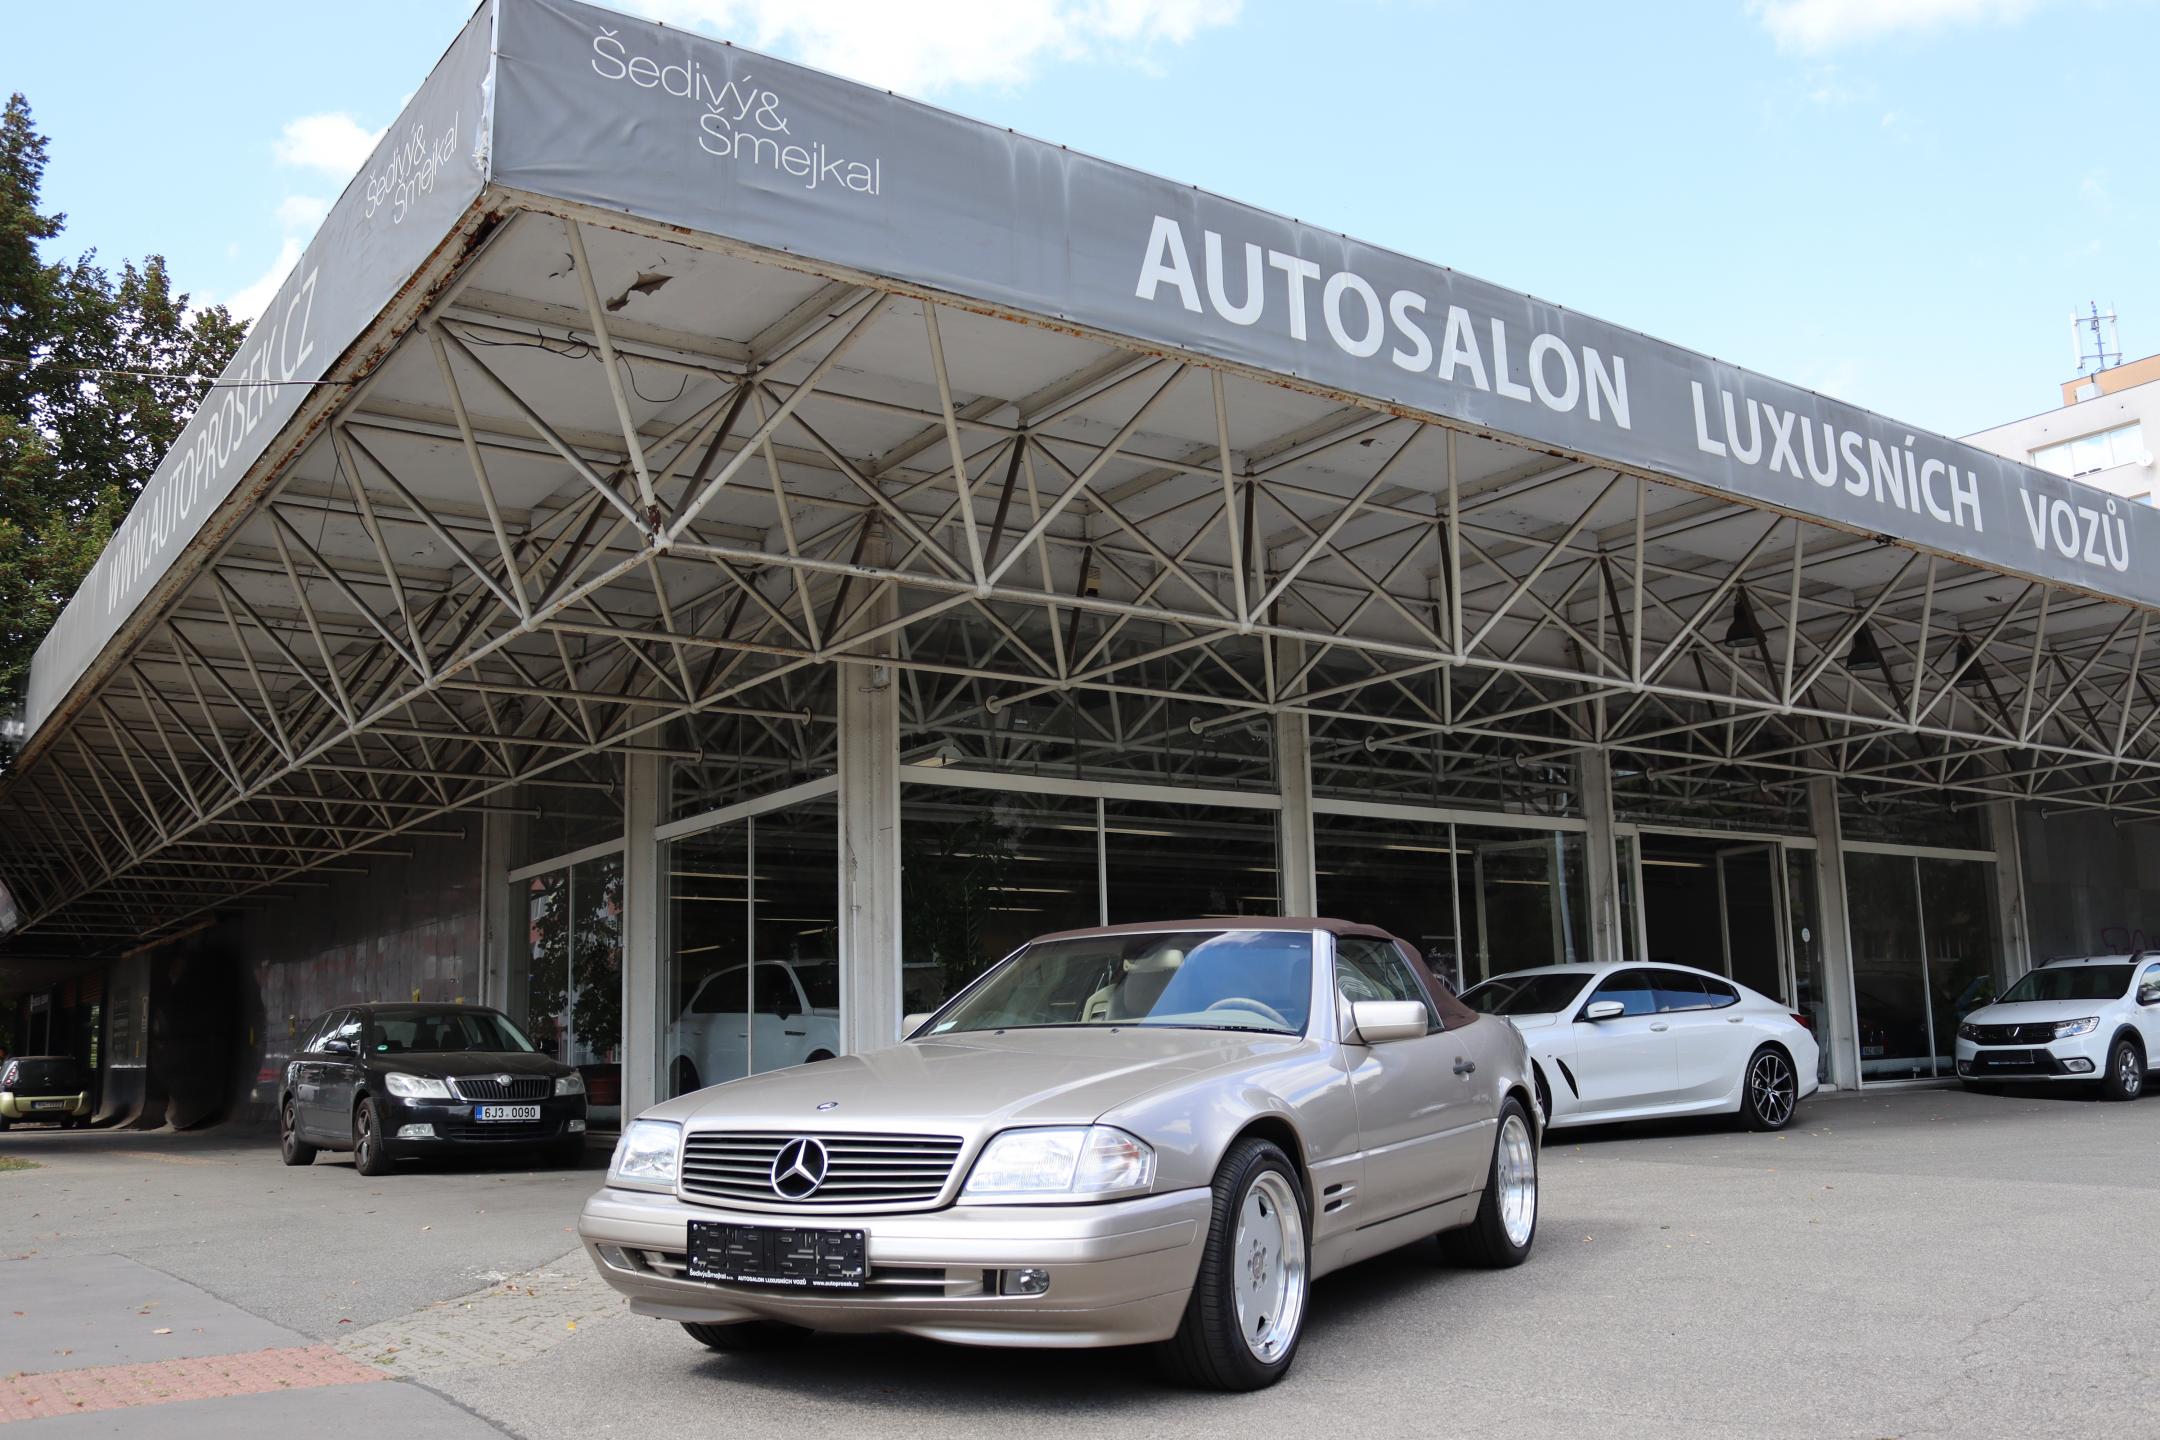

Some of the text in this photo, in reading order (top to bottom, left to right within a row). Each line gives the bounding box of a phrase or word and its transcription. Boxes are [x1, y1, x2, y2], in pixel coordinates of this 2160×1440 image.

[591, 25, 791, 135] Šedivý&
[393, 110, 459, 225] Šmejkal
[698, 102, 880, 196] Šmejkal
[1135, 215, 2129, 572] AUTOSALON LUXUSNÍCH VOZŮ
[484, 1107, 536, 1119] 6J3 0090
